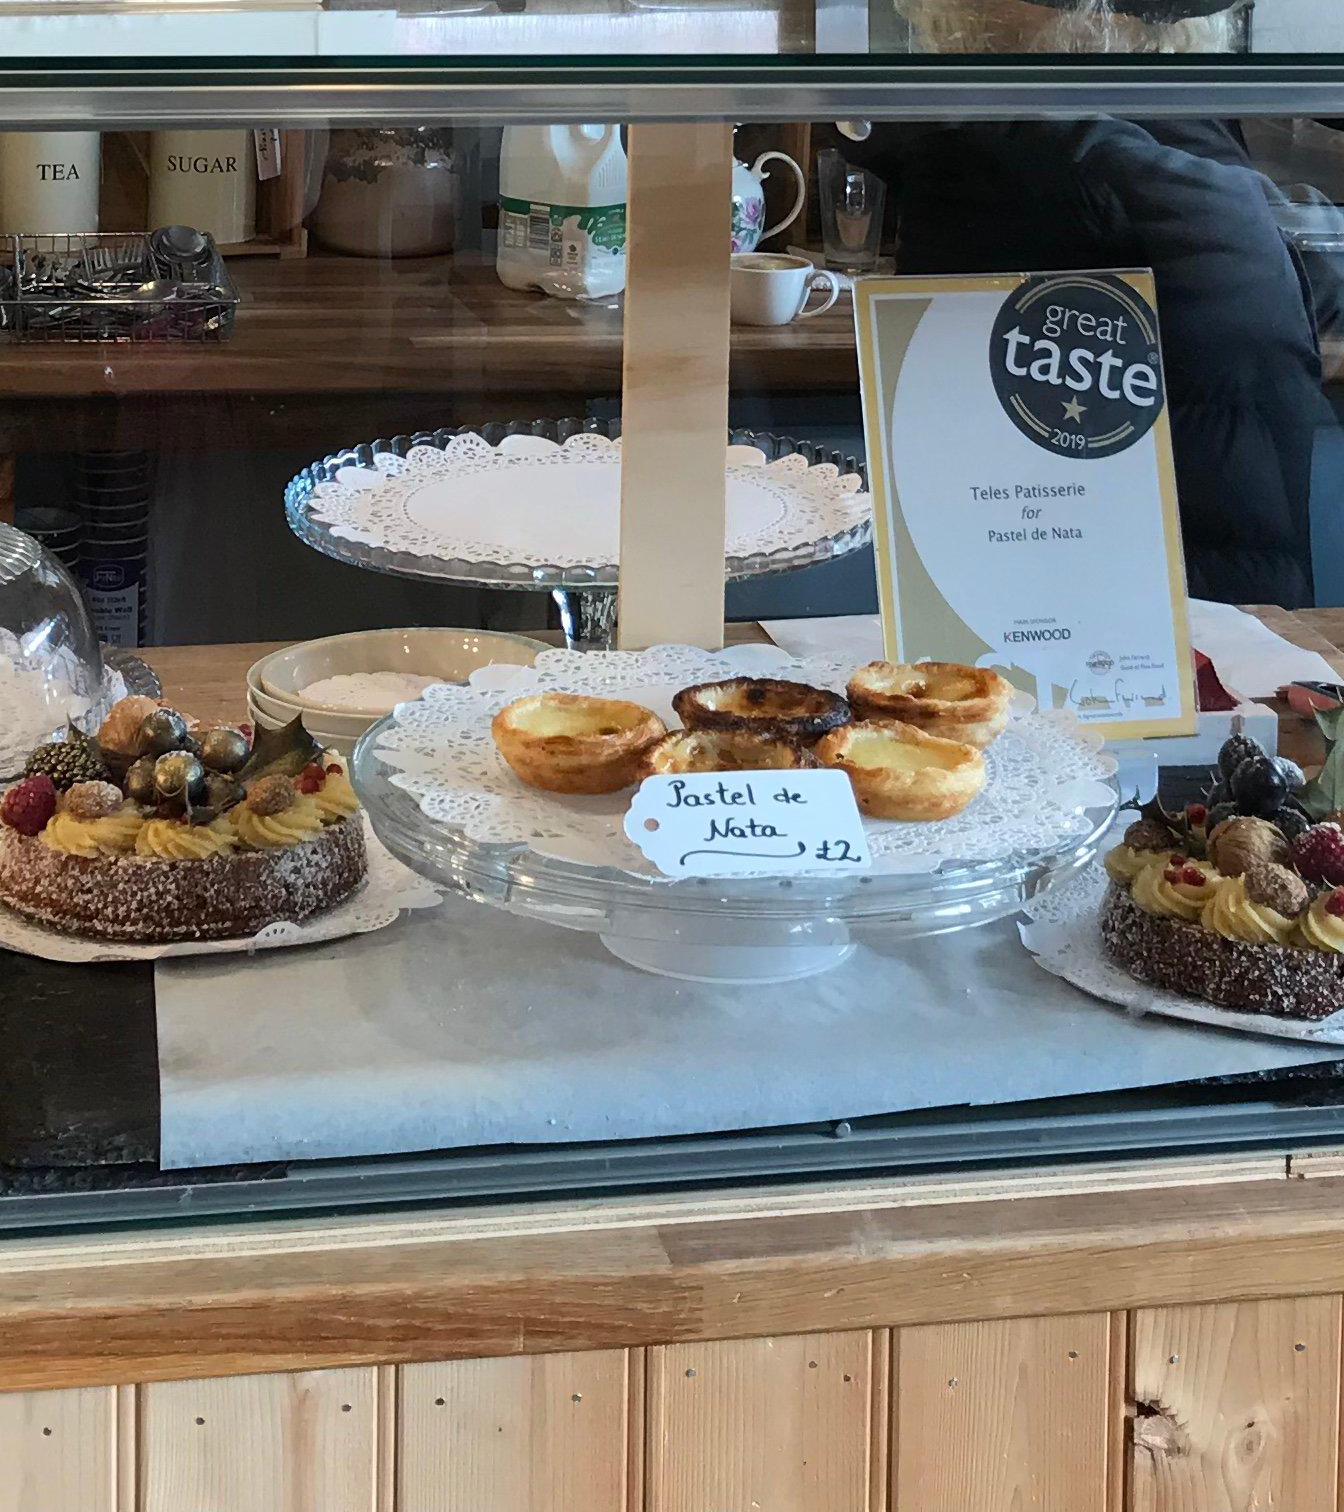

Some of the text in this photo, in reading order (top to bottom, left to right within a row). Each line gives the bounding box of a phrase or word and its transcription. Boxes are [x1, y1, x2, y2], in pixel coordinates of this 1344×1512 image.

[36, 162, 80, 181] TEA
[167, 154, 238, 174] SUGAR
[1042, 304, 1129, 345] great
[1002, 326, 1159, 407] taste
[1050, 427, 1087, 450] 2019
[970, 482, 1087, 501] Teles Patisserie
[1020, 505, 1043, 523] for
[988, 526, 1084, 543] Pastel de Nata
[1003, 628, 1072, 643] KENWOOD
[666, 779, 808, 809] Pastel de
[703, 817, 789, 842] Nata
[815, 839, 863, 863] £2
